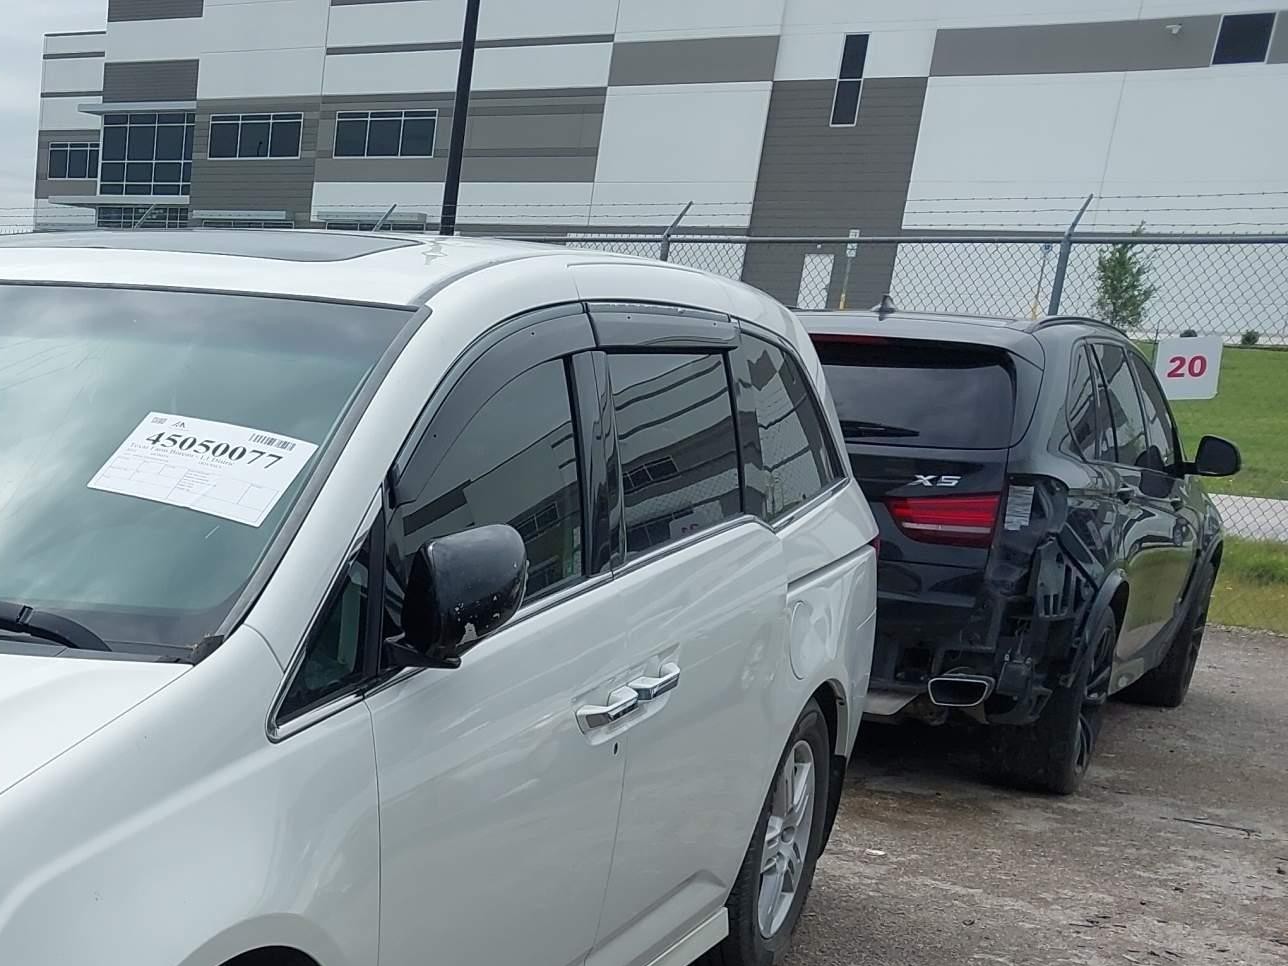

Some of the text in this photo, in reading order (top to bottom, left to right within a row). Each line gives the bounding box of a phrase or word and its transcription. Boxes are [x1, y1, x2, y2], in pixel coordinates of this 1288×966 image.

[1167, 355, 1207, 378] 20
[146, 431, 283, 470] 45050077
[907, 474, 961, 487] X5
